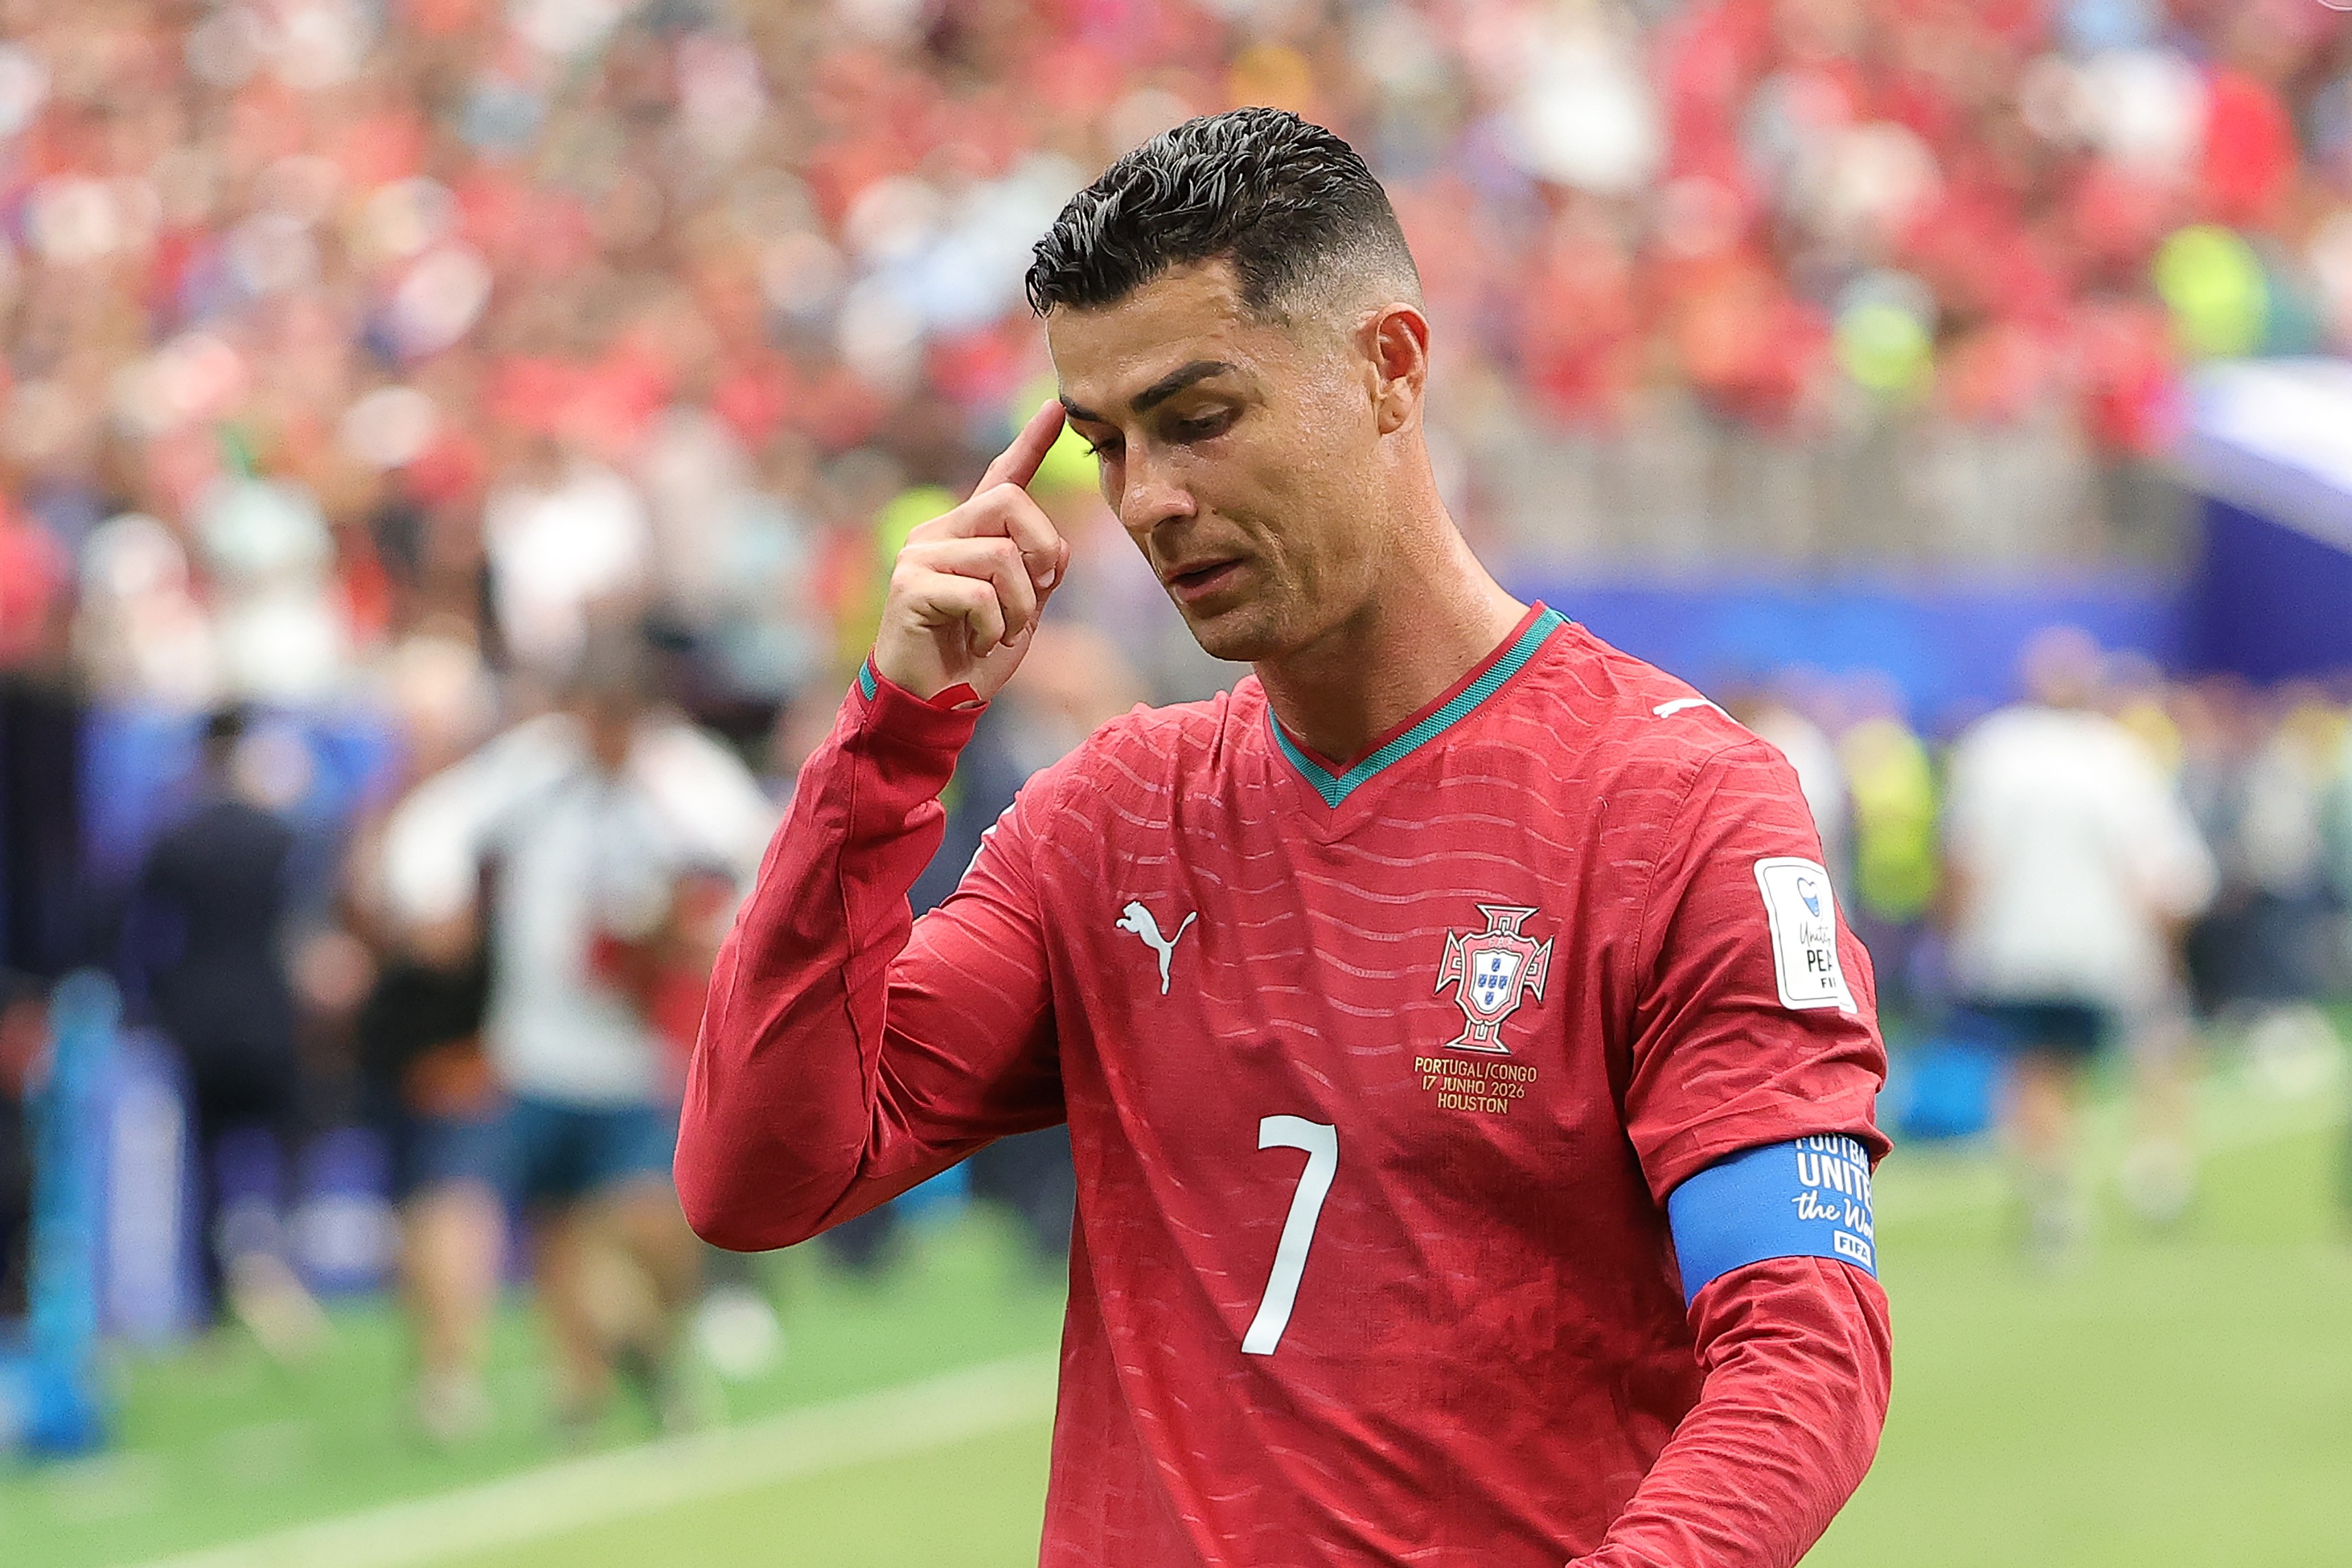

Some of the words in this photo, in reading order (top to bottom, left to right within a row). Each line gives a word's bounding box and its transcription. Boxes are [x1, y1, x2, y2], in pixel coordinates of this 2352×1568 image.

[1415, 1057, 1537, 1083] PORTUGAL/CONGO
[1422, 1075, 1437, 1090] 17
[1440, 1076, 1485, 1094] JUNHO
[1491, 1082, 1525, 1098] 2026
[1437, 1093, 1509, 1114] HOUSTON
[1791, 1189, 1841, 1220] the
[1241, 1115, 1339, 1356] 7
[1839, 1235, 1869, 1261] FIFA
